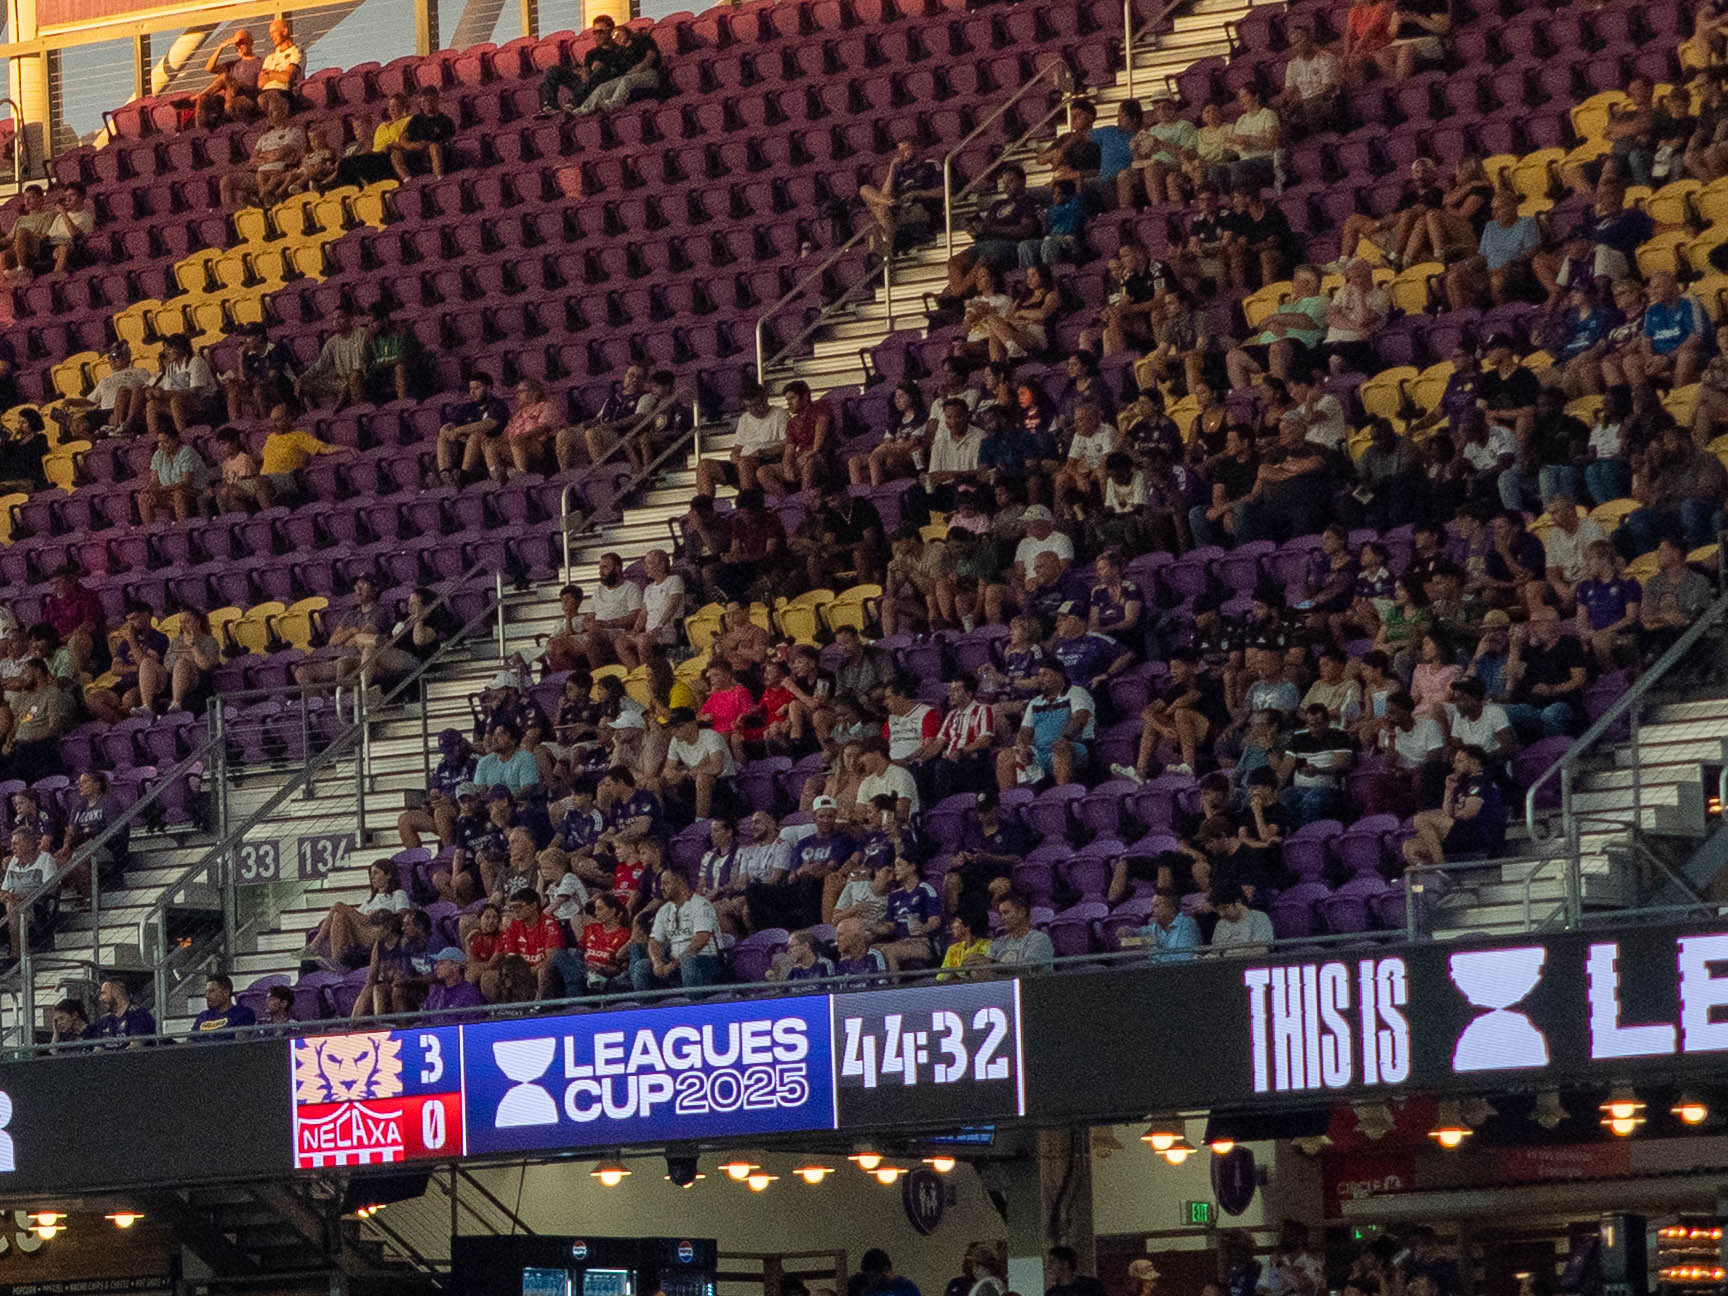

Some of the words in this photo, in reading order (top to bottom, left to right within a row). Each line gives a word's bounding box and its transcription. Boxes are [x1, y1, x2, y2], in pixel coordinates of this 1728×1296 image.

[563, 1017, 810, 1078] LEAGUES
[837, 1005, 1011, 1090] 44:32
[1245, 962, 1353, 1095] THIS
[1360, 957, 1411, 1086] IS
[420, 1034, 444, 1084] 3
[564, 1073, 675, 1122] CUP
[675, 1064, 810, 1115] 2025
[301, 1100, 403, 1152] NECAXA
[421, 1098, 446, 1150] 0
